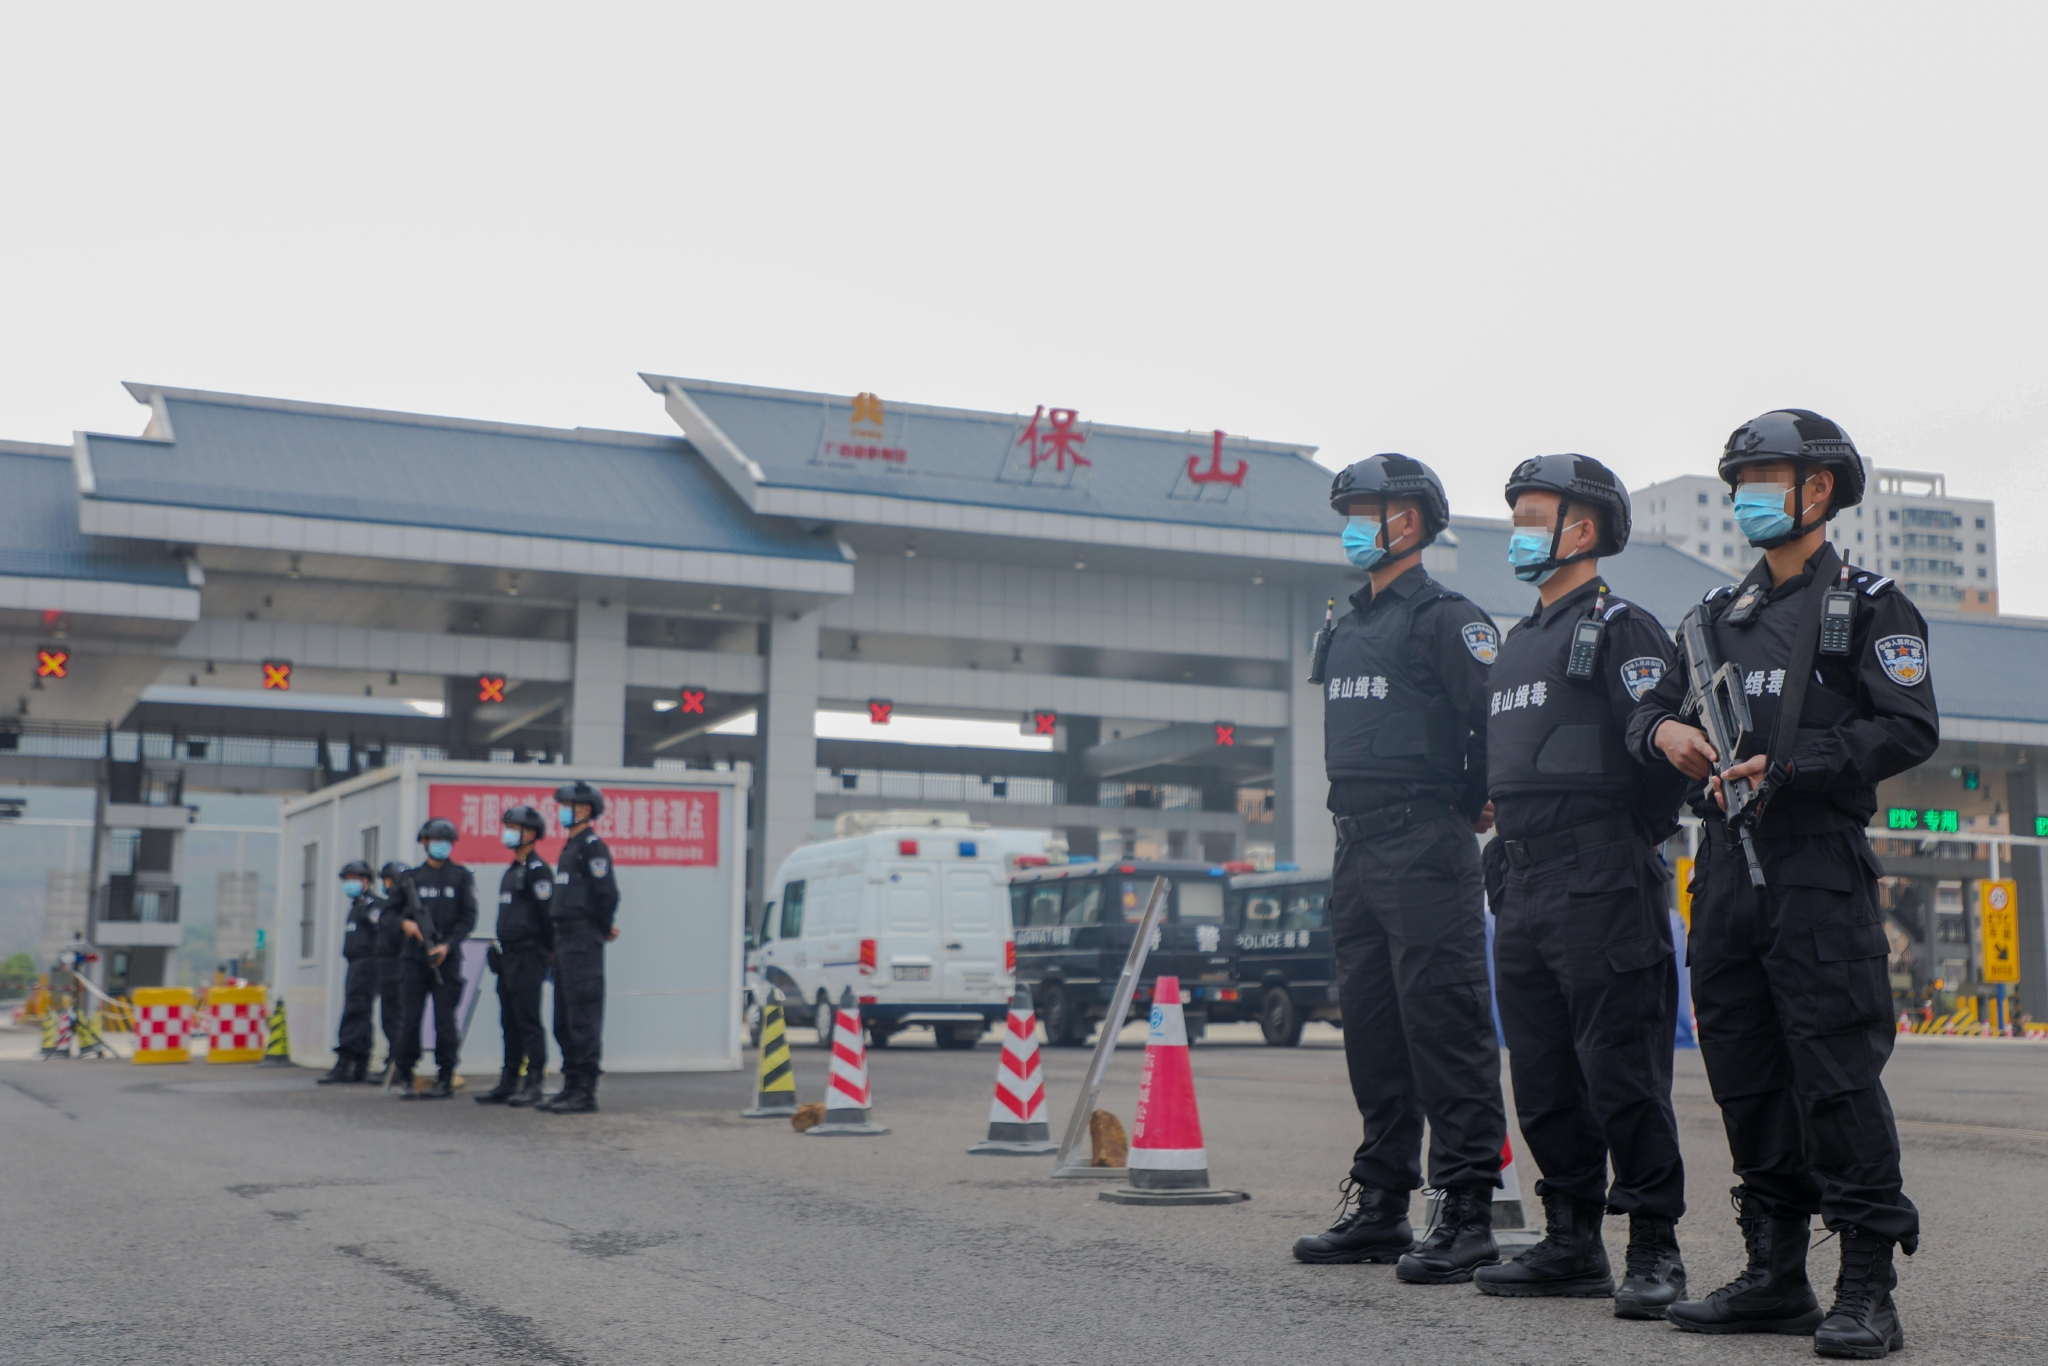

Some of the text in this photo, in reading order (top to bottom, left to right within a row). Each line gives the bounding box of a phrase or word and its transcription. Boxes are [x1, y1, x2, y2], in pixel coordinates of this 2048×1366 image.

[1329, 676, 1389, 701] 保山缉毒
[1745, 668, 1786, 697] 缉毒
[1491, 680, 1548, 717] 保山缉毒
[1236, 933, 1282, 950] POLICE
